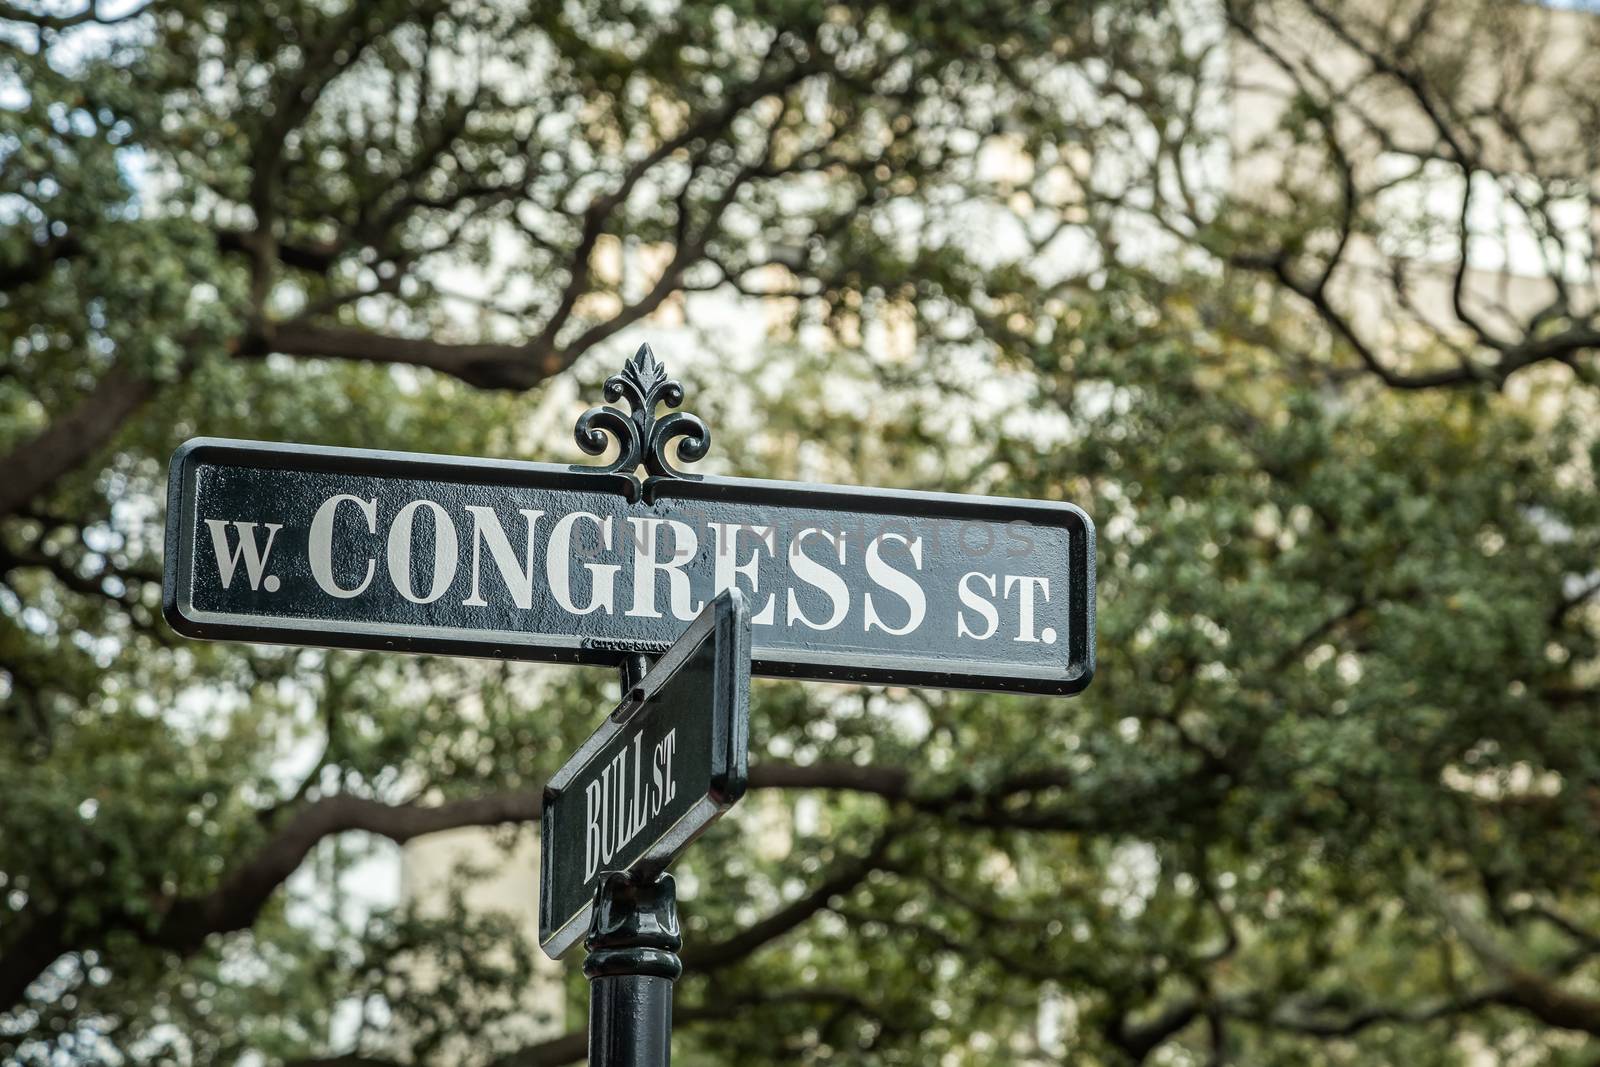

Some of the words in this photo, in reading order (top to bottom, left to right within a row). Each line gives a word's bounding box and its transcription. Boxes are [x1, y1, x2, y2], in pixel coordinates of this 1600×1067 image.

[204, 518, 281, 593] W.
[308, 493, 927, 636] CONGRESS
[957, 571, 1057, 644] ST.
[583, 729, 648, 885] BULL
[652, 727, 676, 819] ST.
